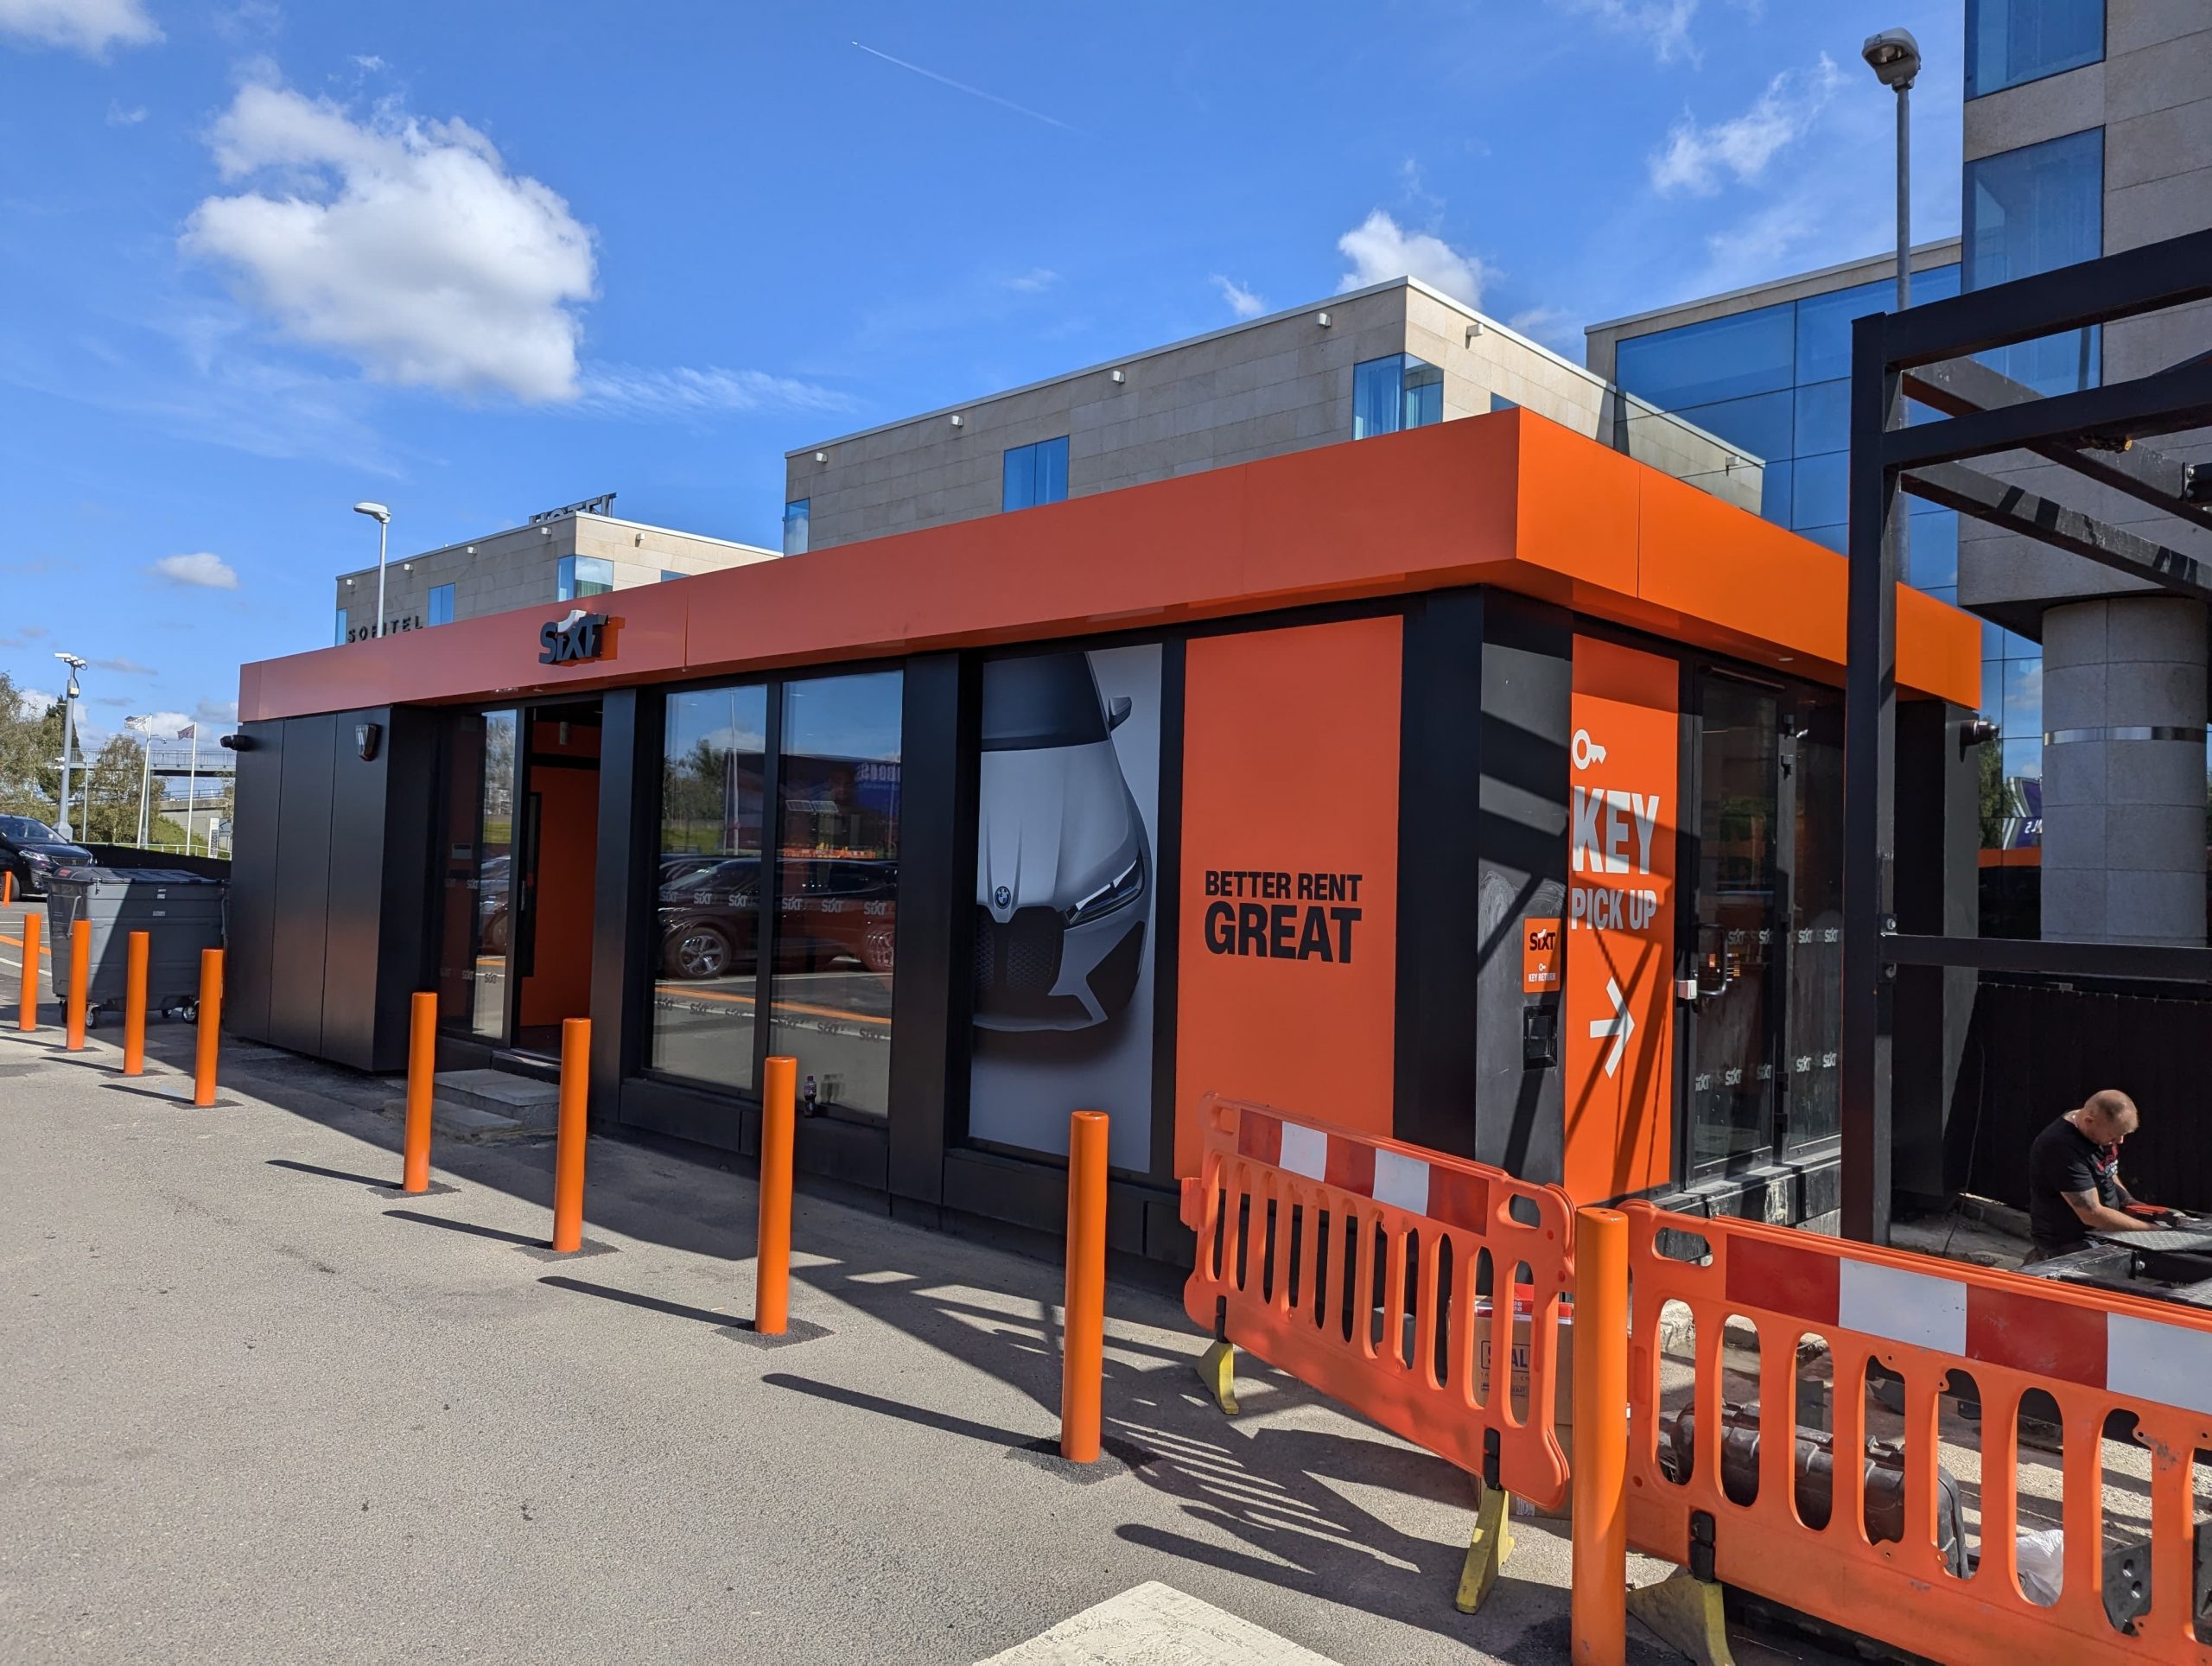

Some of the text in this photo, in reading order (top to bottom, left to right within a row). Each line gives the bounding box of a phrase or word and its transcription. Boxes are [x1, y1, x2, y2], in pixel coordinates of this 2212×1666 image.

[348, 615, 423, 643] SOFITEL
[1573, 785, 1660, 874] KEY
[1205, 870, 1363, 901] BETTER RENT
[1571, 887, 1657, 931] PICK UP
[1205, 900, 1362, 964] GREAT
[1529, 972, 1556, 982] KEY RETURN
